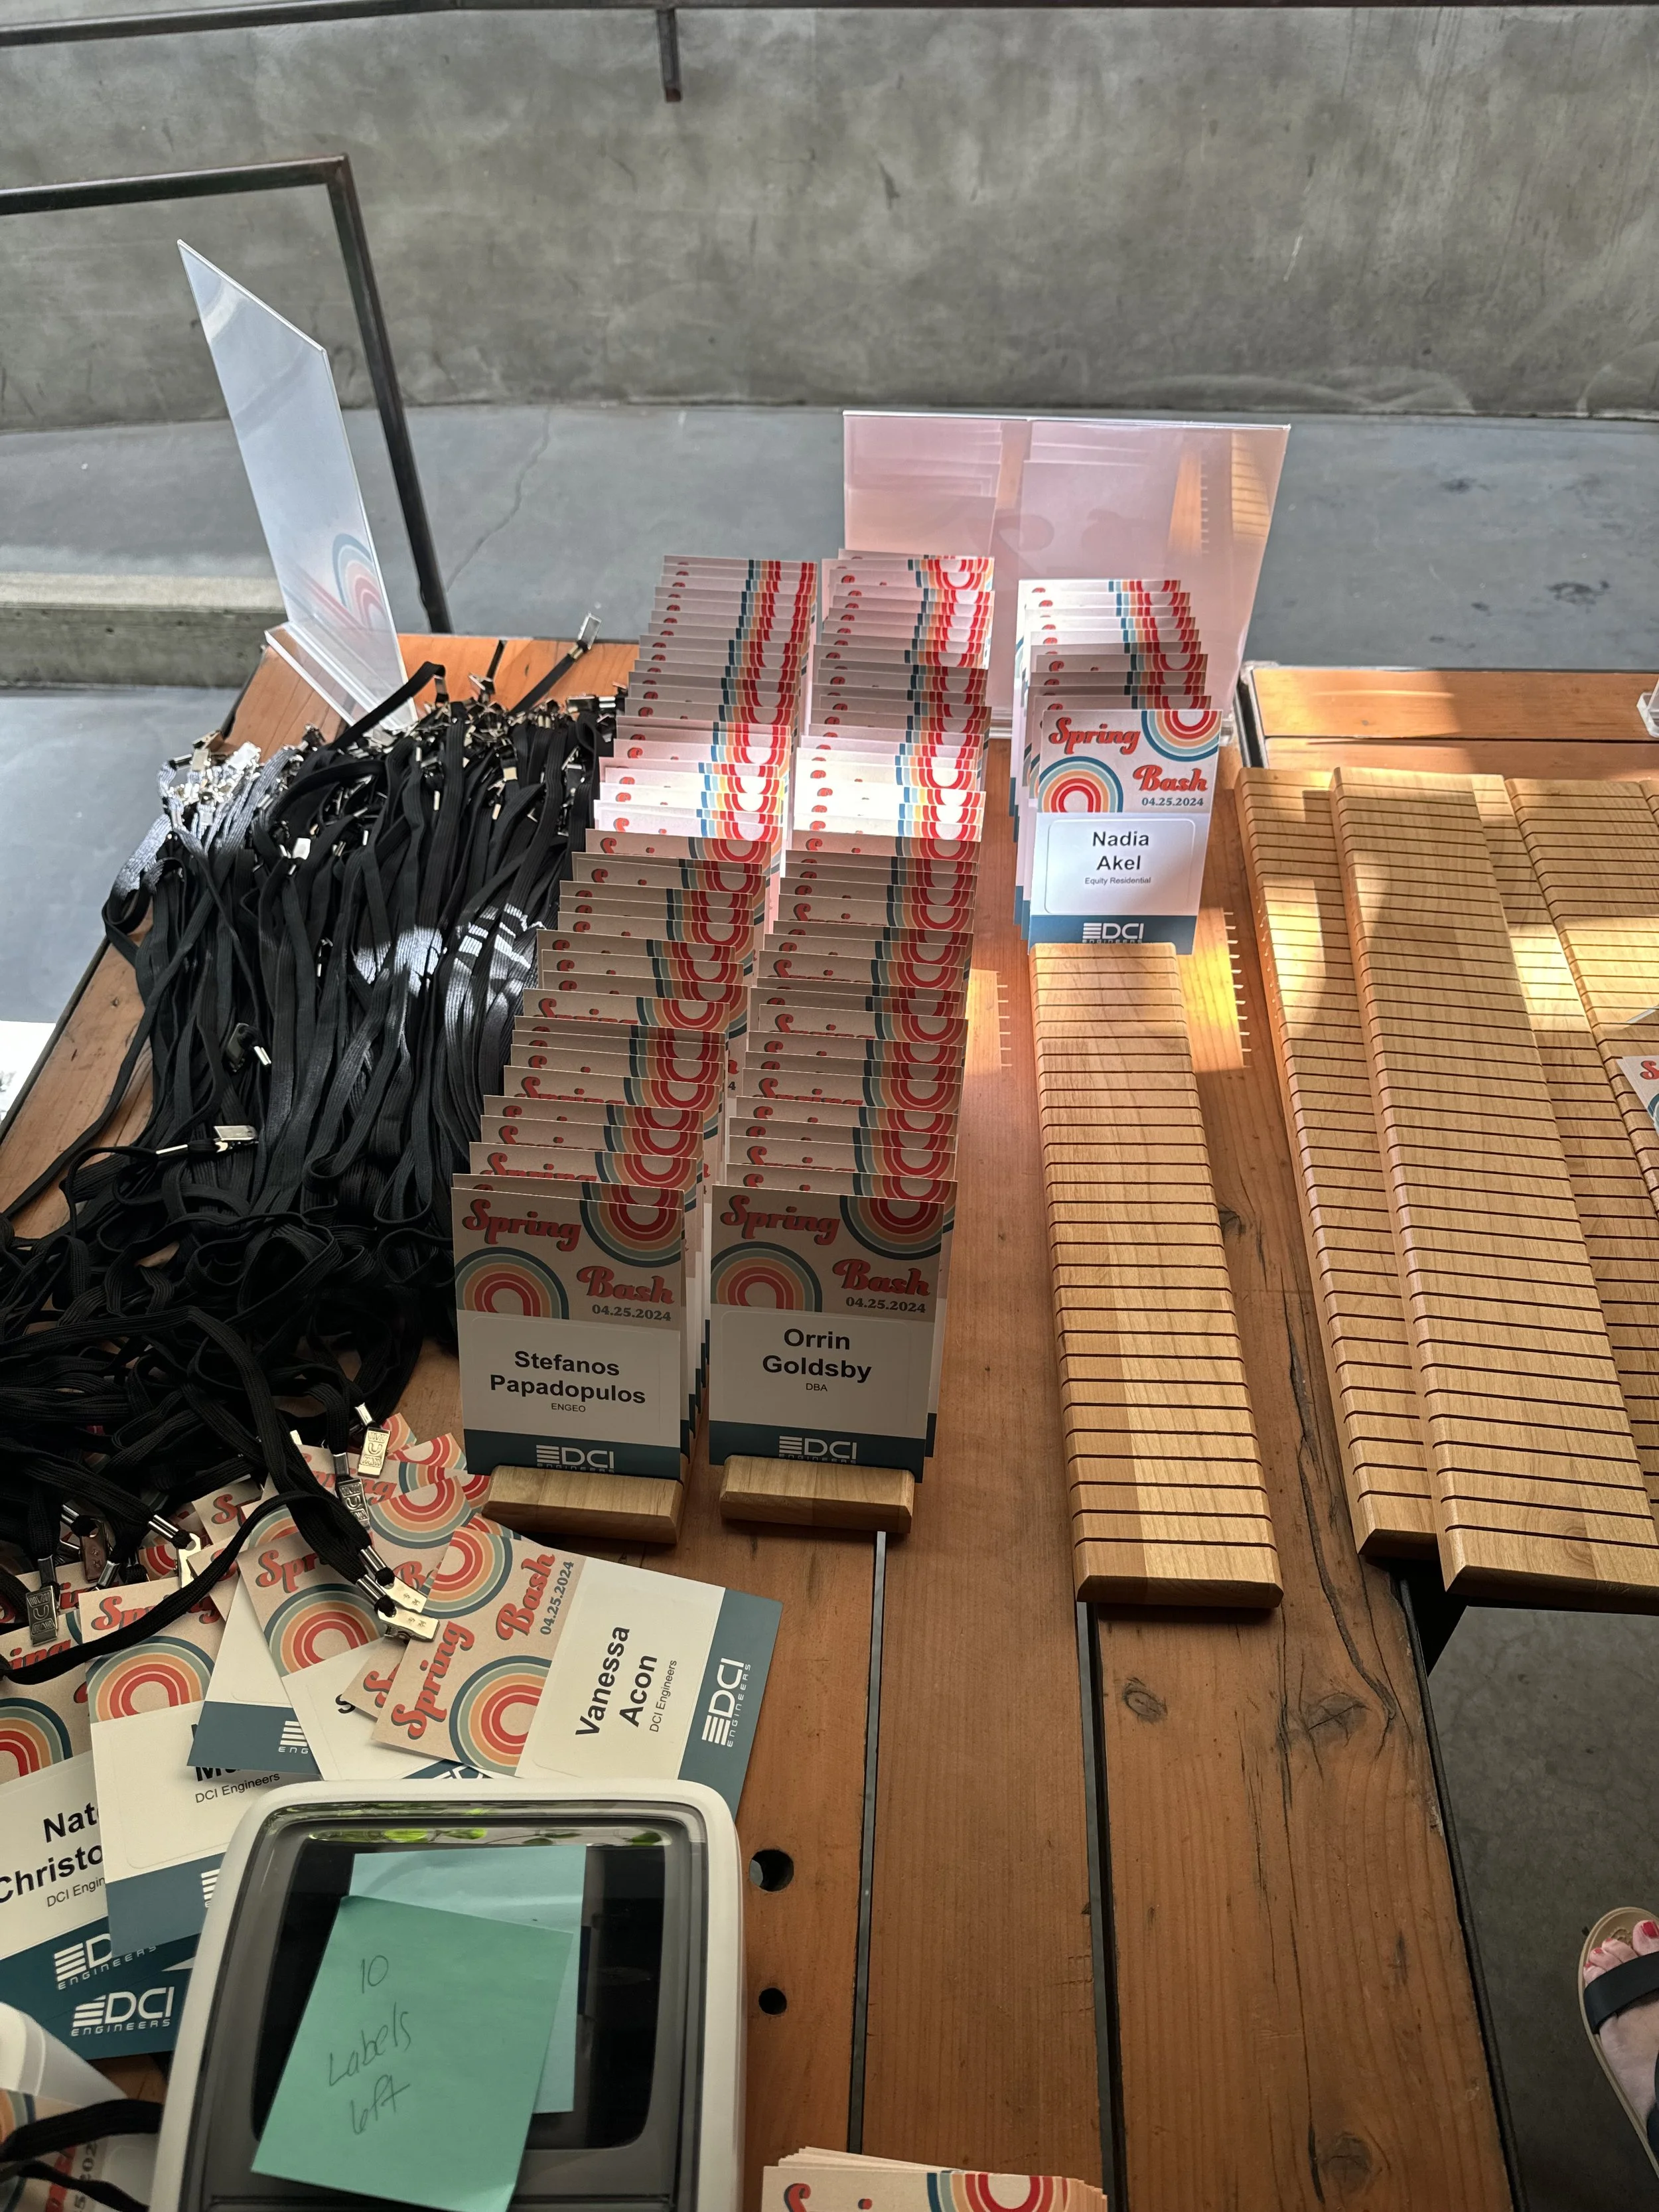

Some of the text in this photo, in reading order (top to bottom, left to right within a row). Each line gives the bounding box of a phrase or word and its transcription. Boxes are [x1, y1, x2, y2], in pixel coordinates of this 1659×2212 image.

[1048, 717, 1141, 755] Spring
[1133, 765, 1208, 792] Bash
[1141, 797, 1203, 806] 04.25.2024
[1092, 831, 1149, 847] Nadia
[1096, 855, 1141, 871] Akel
[1084, 876, 1151, 886] Equity Residential
[462, 1198, 581, 1252] Spring
[720, 1195, 841, 1246] Spring
[576, 1265, 674, 1305] Bash
[831, 1258, 930, 1297] Bash
[592, 1303, 672, 1321] 04.25.2024
[845, 1296, 926, 1313] 04.25.2024
[784, 1328, 850, 1351] Orrin
[514, 1350, 620, 1376] Stefanos
[762, 1355, 872, 1384] Goldsby
[490, 1374, 646, 1404] Papadopulos
[805, 1382, 828, 1392] DBA
[550, 1402, 587, 1413] ENGEO
[496, 1554, 556, 1641] Bash
[540, 1560, 575, 1635] 04.25.2024
[391, 1621, 475, 1740] Spring
[575, 1626, 630, 1736] Vanessa
[618, 1655, 658, 1728] Acon
[649, 1660, 677, 1733] DCI Engineers
[195, 1789, 218, 1804] DCI
[222, 1773, 281, 1796] Engineers
[43, 1803, 100, 1843] Nat
[46, 1877, 105, 1907] DCI Engin
[361, 1954, 389, 1994] 10
[329, 2001, 411, 2087] Labels
